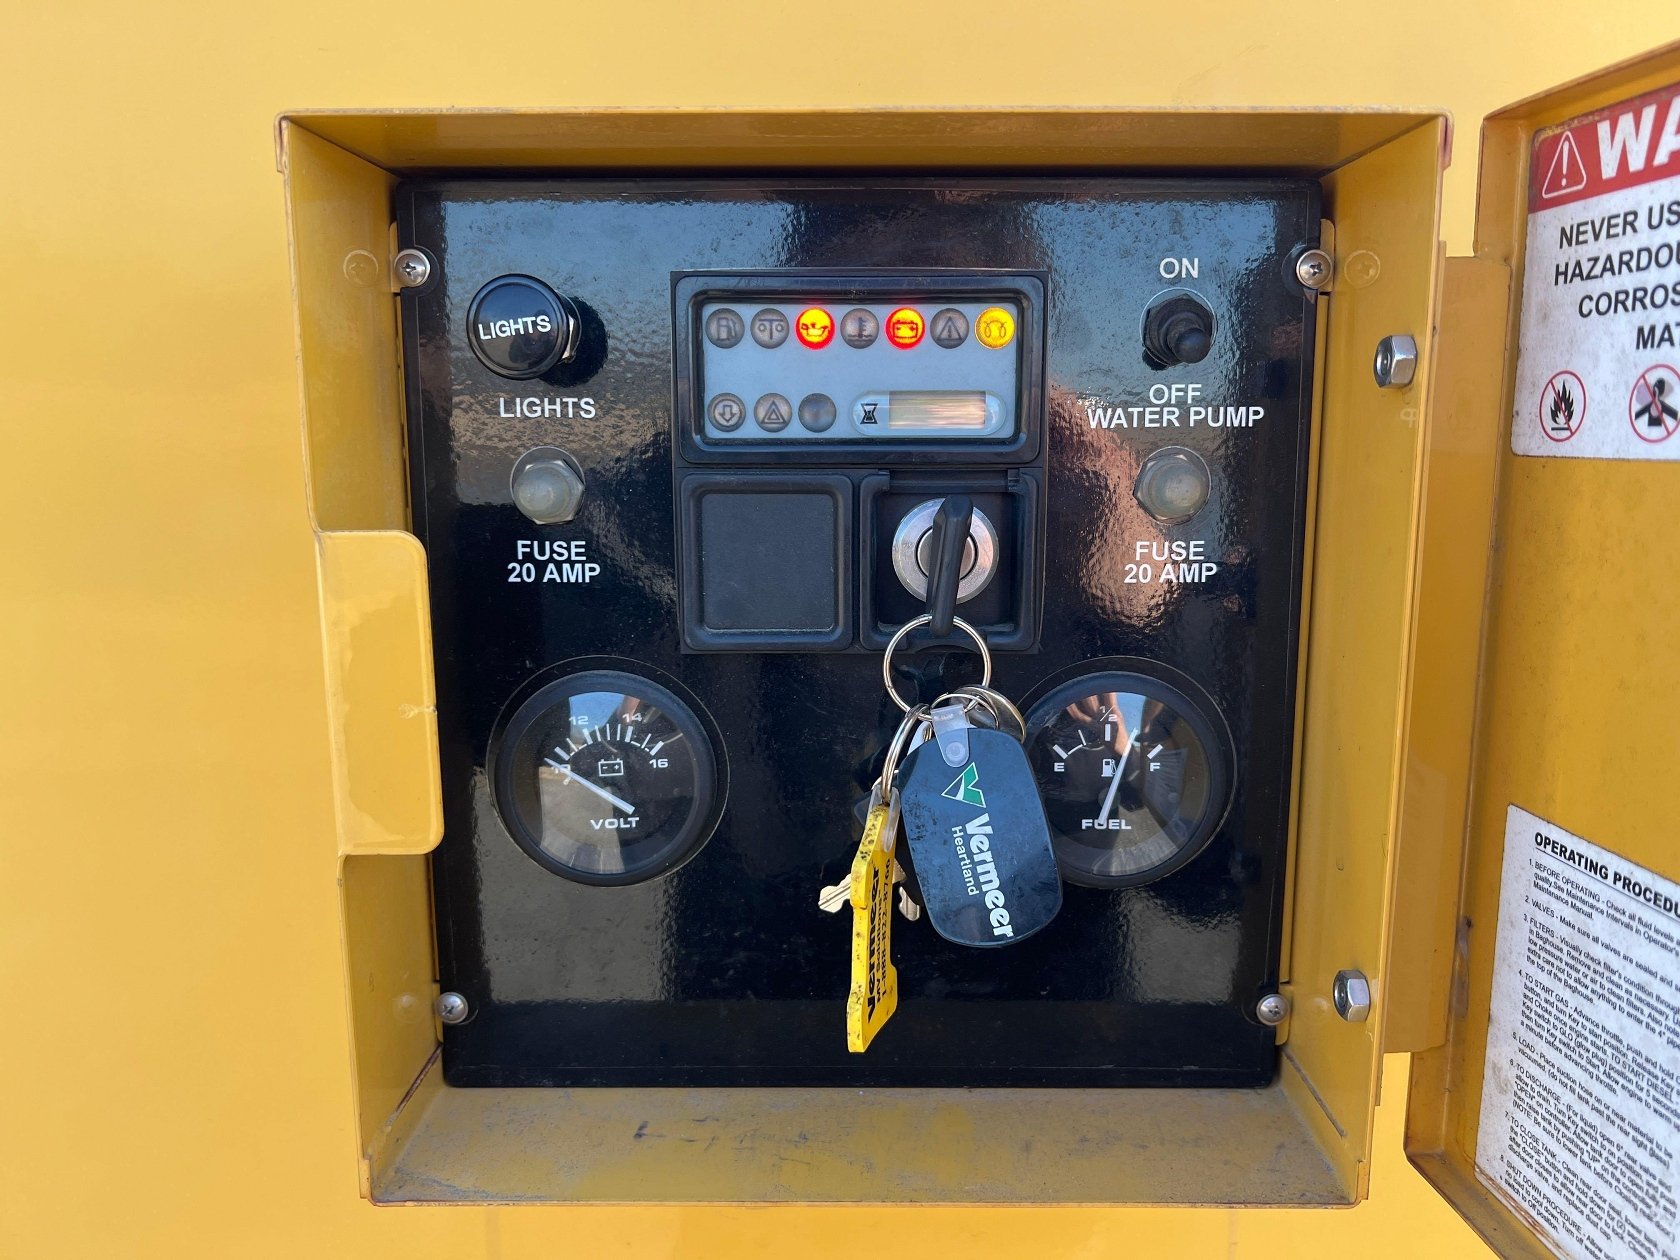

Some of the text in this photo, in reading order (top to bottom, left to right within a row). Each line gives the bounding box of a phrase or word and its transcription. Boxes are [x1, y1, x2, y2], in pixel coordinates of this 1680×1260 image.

[1559, 210, 1638, 249] NEVER
[1159, 258, 1199, 279] ON
[478, 315, 552, 341] LIGHTS
[499, 397, 596, 419] LIGHTS
[1149, 384, 1202, 405] OFF
[1087, 406, 1264, 428] WATER PUMP
[516, 540, 587, 561] FUSE
[1135, 541, 1205, 561] FUSE
[507, 563, 601, 583] 20 AMP
[1123, 562, 1217, 584] 20 AMP
[568, 715, 589, 725] 12
[622, 713, 642, 722] 14
[649, 759, 668, 769] 16
[1053, 763, 1065, 772] E
[1150, 763, 1160, 772] F
[590, 817, 640, 830] VOLT
[1081, 819, 1131, 830] FUEL
[951, 825, 979, 896] Heartland
[1534, 832, 1609, 880] OPERATING
[965, 813, 1015, 938] Vermeer
[1535, 861, 1561, 882] BEFORE
[1561, 875, 1600, 903] OPERATING
[1606, 899, 1626, 917] Check
[1628, 912, 1636, 922] all
[1638, 916, 1652, 931] fluid
[1653, 924, 1674, 943] levels
[1606, 909, 1634, 932] Intervals
[1635, 925, 1641, 936] in
[867, 865, 880, 1024] Vermeer
[1530, 917, 1555, 939] FILTERS
[1560, 935, 1582, 957] Visually
[1583, 951, 1602, 967] check
[1623, 975, 1653, 999] condition
[1531, 898, 1555, 919] VALVES
[1560, 915, 1575, 931] Make
[1577, 926, 1590, 940] sure
[1591, 935, 1600, 945] all
[1600, 940, 1621, 957] valves
[1623, 953, 1634, 965] are
[1635, 961, 1658, 979] sealed
[1659, 975, 1673, 988] and
[1526, 954, 1535, 966] the
[1536, 961, 1546, 975] top
[1546, 969, 1553, 977] of
[1553, 971, 1563, 984] the
[1529, 926, 1535, 936] in
[1566, 949, 1591, 971] Remove
[1592, 967, 1605, 979] and
[1606, 976, 1623, 991] clean
[1624, 987, 1633, 997] as
[1528, 935, 1538, 948] low
[1539, 944, 1563, 964] pressure
[1565, 960, 1580, 975] water
[1590, 976, 1598, 986] air
[1599, 980, 1606, 991] to
[1607, 987, 1625, 1003] clean
[1626, 997, 1646, 1016] filters.
[1647, 1010, 1663, 1027] Also
[1573, 976, 1589, 991] allow
[1590, 987, 1617, 1011] anything
[1626, 1010, 1644, 1026] enter
[1522, 1000, 1533, 1015] Key
[1609, 1063, 1634, 1086] position
[1524, 982, 1543, 1003] button,
[1568, 1012, 1580, 1028] Key
[1632, 1056, 1659, 1081] Release
[1661, 1076, 1675, 1094] Key
[1525, 972, 1534, 984] TO
[1535, 979, 1554, 998] START
[1555, 993, 1569, 1009] GAS
[1574, 1005, 1600, 1030] Advance
[1626, 1043, 1643, 1059] push
[1659, 1063, 1674, 1080] hold
[1535, 999, 1552, 1017] Choke
[1553, 1014, 1568, 1028] once
[1569, 1024, 1589, 1043] engine
[1611, 1052, 1621, 1065] TO
[1622, 1060, 1645, 1083] START
[1647, 1077, 1674, 1103] DIESEL
[1545, 1036, 1563, 1055] before
[1564, 1052, 1594, 1080] advancing
[1546, 1028, 1619, 1086] Key switch Allow
[1519, 1036, 1654, 1145] LOAD Place suction material
